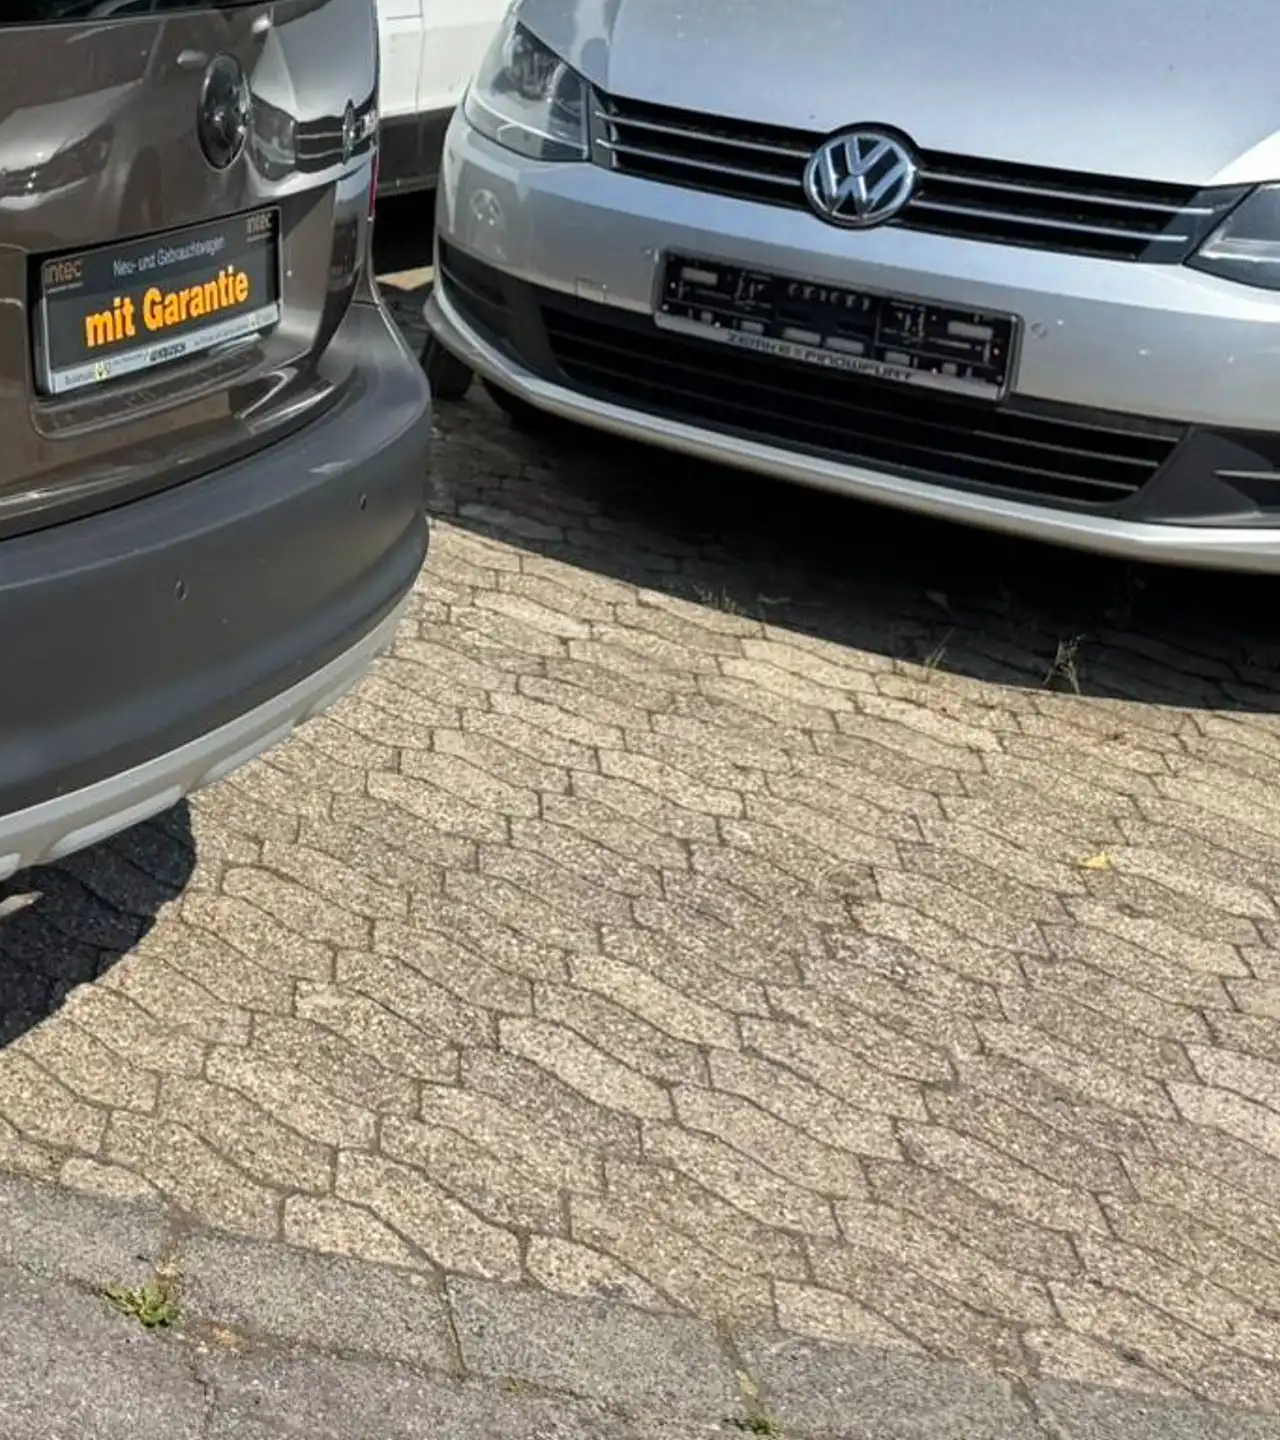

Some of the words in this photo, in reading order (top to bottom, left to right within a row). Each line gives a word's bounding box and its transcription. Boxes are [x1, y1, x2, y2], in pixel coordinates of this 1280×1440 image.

[45, 260, 82, 284] intec
[138, 253, 156, 270] und
[85, 296, 136, 347] mit
[142, 264, 250, 332] Garantie
